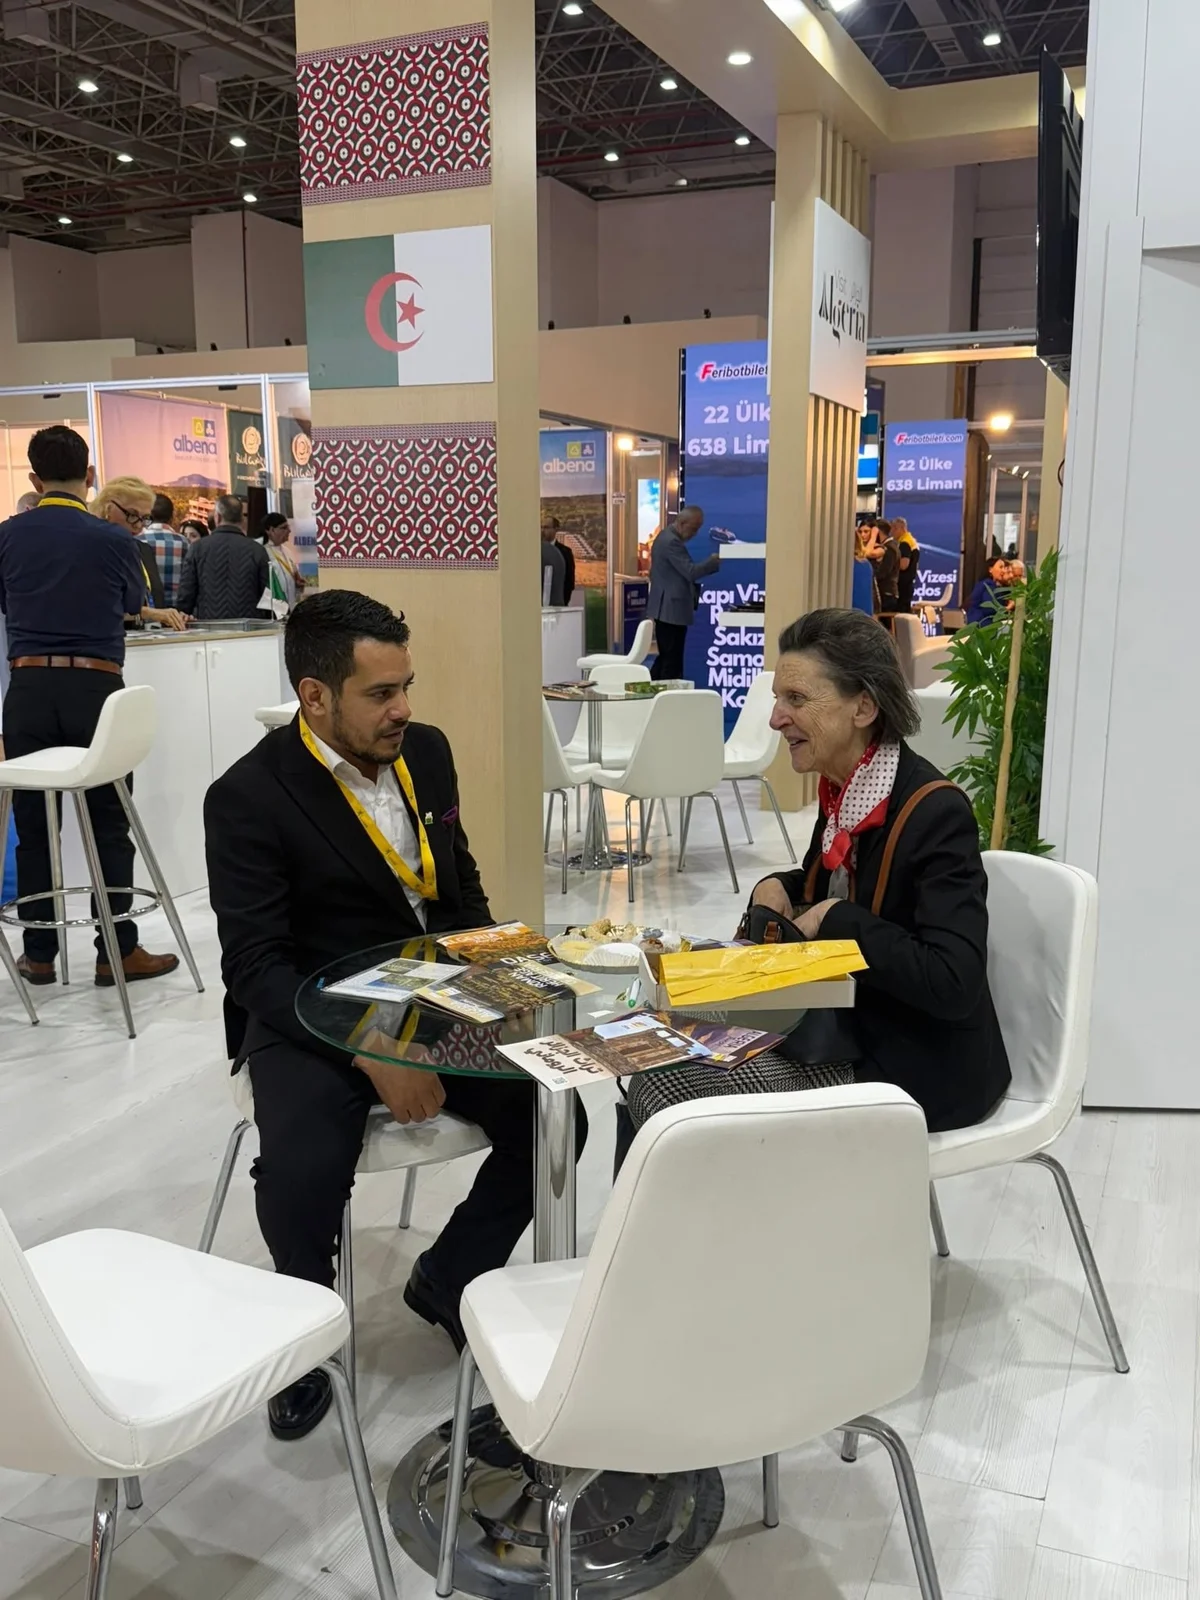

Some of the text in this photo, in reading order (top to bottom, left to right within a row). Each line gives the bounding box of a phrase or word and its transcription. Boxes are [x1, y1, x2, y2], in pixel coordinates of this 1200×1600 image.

[818, 272, 866, 347] Algeria
[703, 400, 771, 424] 22 Ülk
[173, 434, 217, 455] albena
[687, 434, 770, 456] 638 Lim
[897, 433, 962, 445] Feribotbileti.com
[542, 458, 595, 473] albena
[898, 456, 953, 471] 22 Ülke
[886, 477, 962, 491] 638 Liman
[916, 570, 957, 583] Vizesi
[698, 584, 734, 605] apı
[713, 625, 765, 646] Sakız
[524, 1047, 578, 1075] الروماني
[539, 1040, 604, 1075] تراث الجزائر
